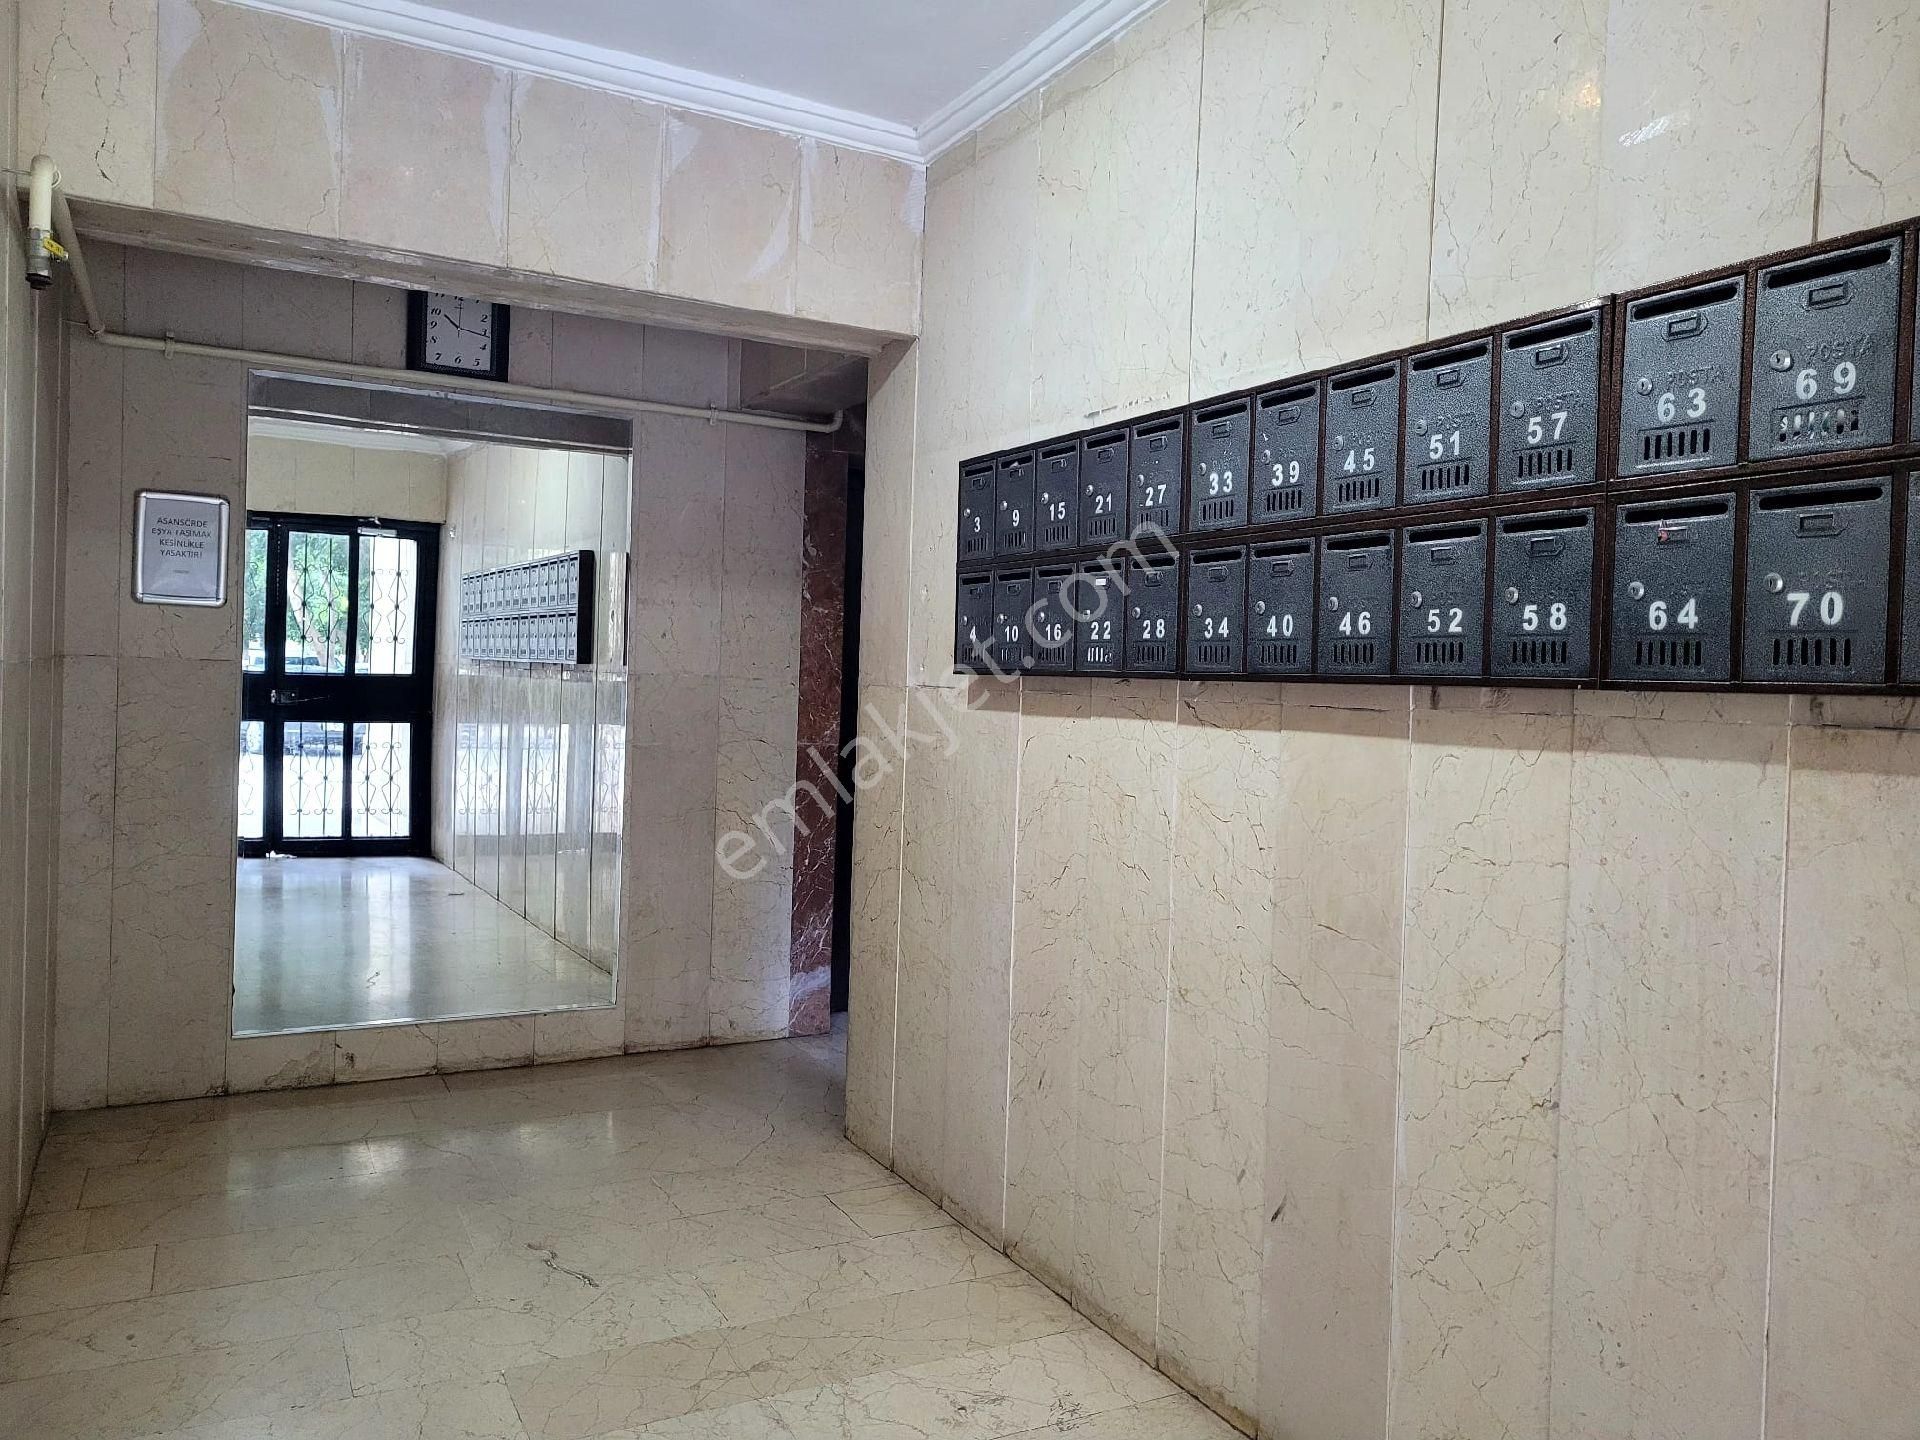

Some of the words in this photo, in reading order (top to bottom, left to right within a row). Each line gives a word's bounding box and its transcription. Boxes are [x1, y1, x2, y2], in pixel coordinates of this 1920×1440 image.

[431, 321, 437, 329] 9
[435, 353, 441, 361] 7
[455, 356, 461, 364] 6
[1795, 362, 1856, 401] 69
[1656, 388, 1707, 425] 63
[1527, 411, 1567, 444] 57
[1429, 430, 1460, 459] 51
[1344, 448, 1374, 473] 45
[1209, 469, 1233, 496] 33
[1272, 461, 1299, 486] 39
[1095, 492, 1112, 514] 21
[1145, 483, 1167, 507] 27
[1012, 509, 1020, 527] 9
[1049, 501, 1066, 521] 15
[974, 516, 981, 533] 3
[1428, 608, 1462, 632] 52
[1523, 603, 1566, 630] 58
[1649, 598, 1698, 630] 64
[1787, 592, 1843, 625] 70
[969, 625, 977, 643] 4
[1004, 625, 1019, 642] 10
[1045, 623, 1062, 641] 16
[1090, 620, 1111, 640] 22
[1142, 618, 1166, 639] 28
[1204, 616, 1230, 639] 34
[1267, 614, 1293, 637] 40
[1339, 612, 1370, 635] 46
